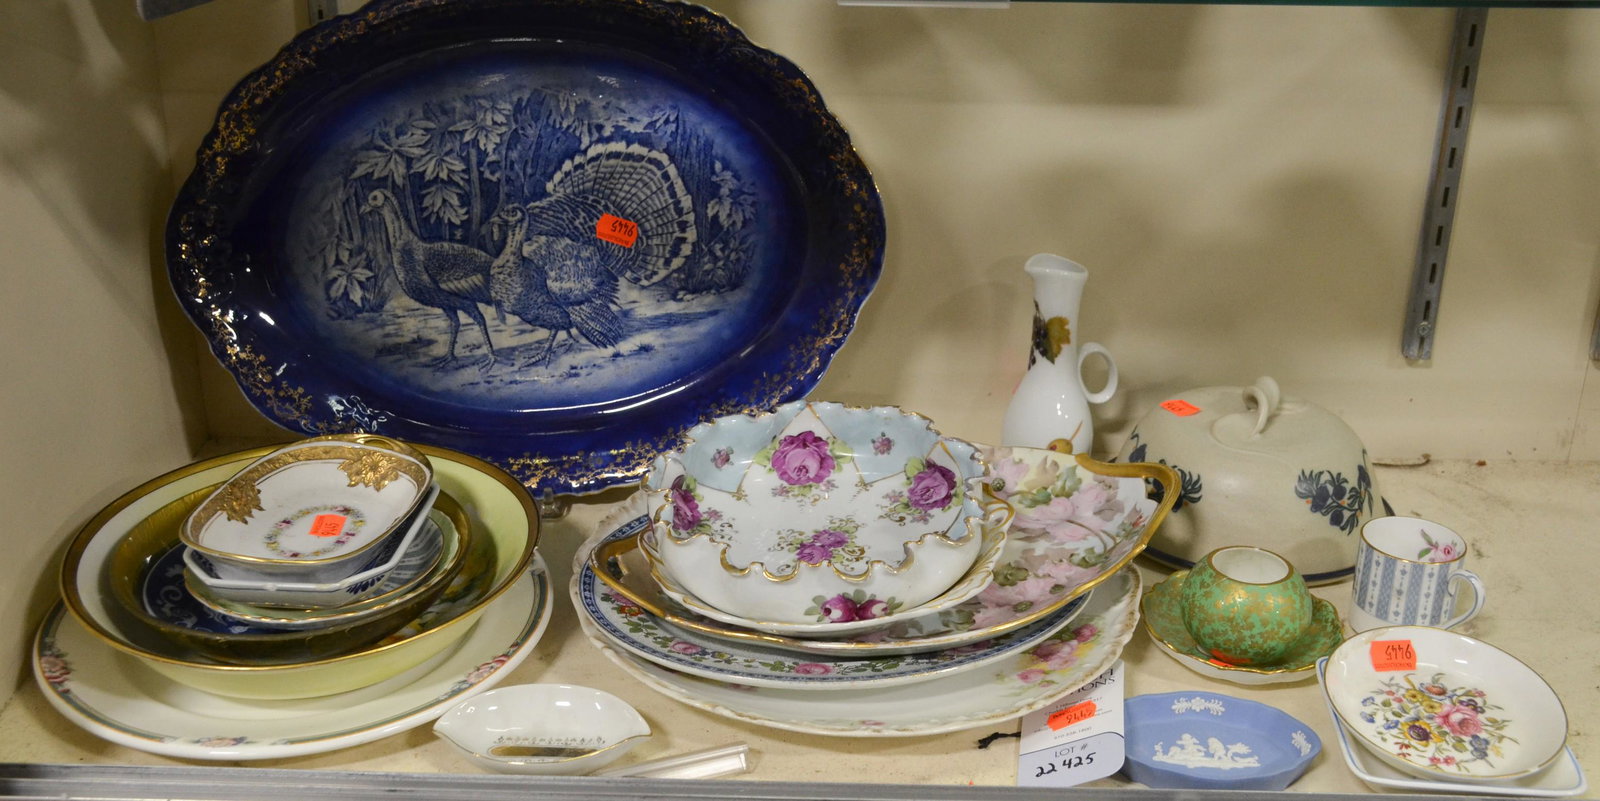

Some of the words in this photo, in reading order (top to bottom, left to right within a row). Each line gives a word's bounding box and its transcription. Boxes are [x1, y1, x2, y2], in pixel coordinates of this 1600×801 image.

[611, 219, 636, 238] 9445
[1384, 643, 1412, 661] 9445
[1054, 746, 1075, 758] LOT
[1080, 743, 1088, 751] #
